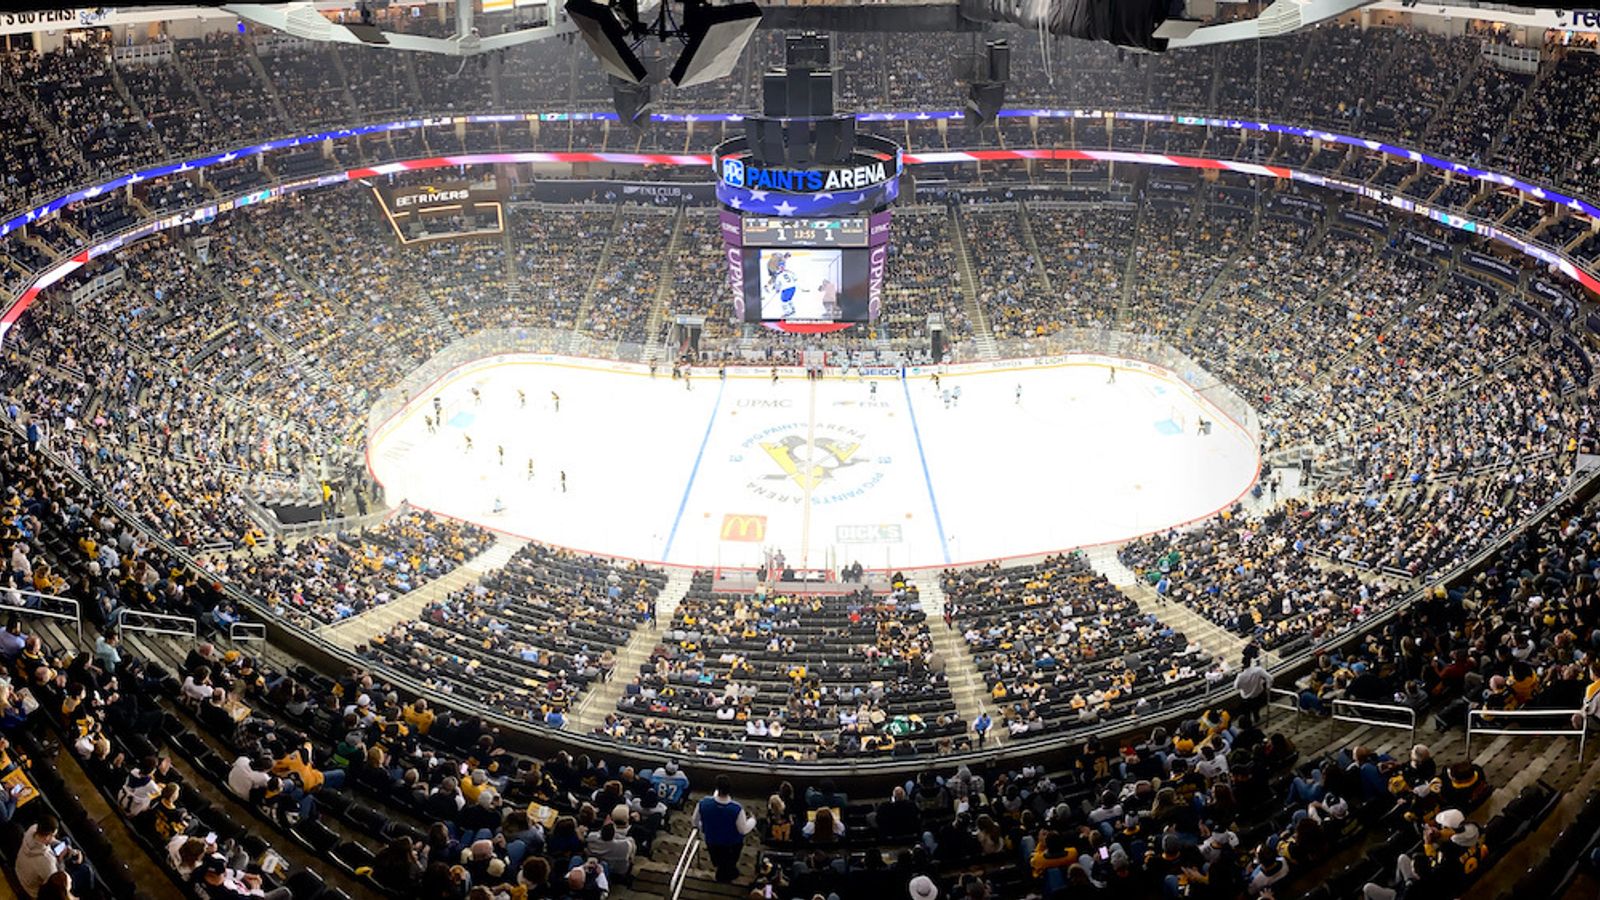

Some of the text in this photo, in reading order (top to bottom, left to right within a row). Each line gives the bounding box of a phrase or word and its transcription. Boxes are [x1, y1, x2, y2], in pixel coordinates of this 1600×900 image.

[747, 167, 823, 190] PAINTS
[825, 163, 886, 190] ARENA
[396, 190, 469, 207] BETRIVERS
[777, 229, 787, 241] 1
[825, 229, 835, 241] 1
[728, 248, 745, 314] UPMC
[868, 247, 885, 318] UPMC
[862, 368, 897, 376] GEICO
[736, 399, 793, 408] UPMC
[816, 422, 867, 440] ARENA
[746, 482, 803, 505] ARENA
[657, 783, 677, 799] 87
